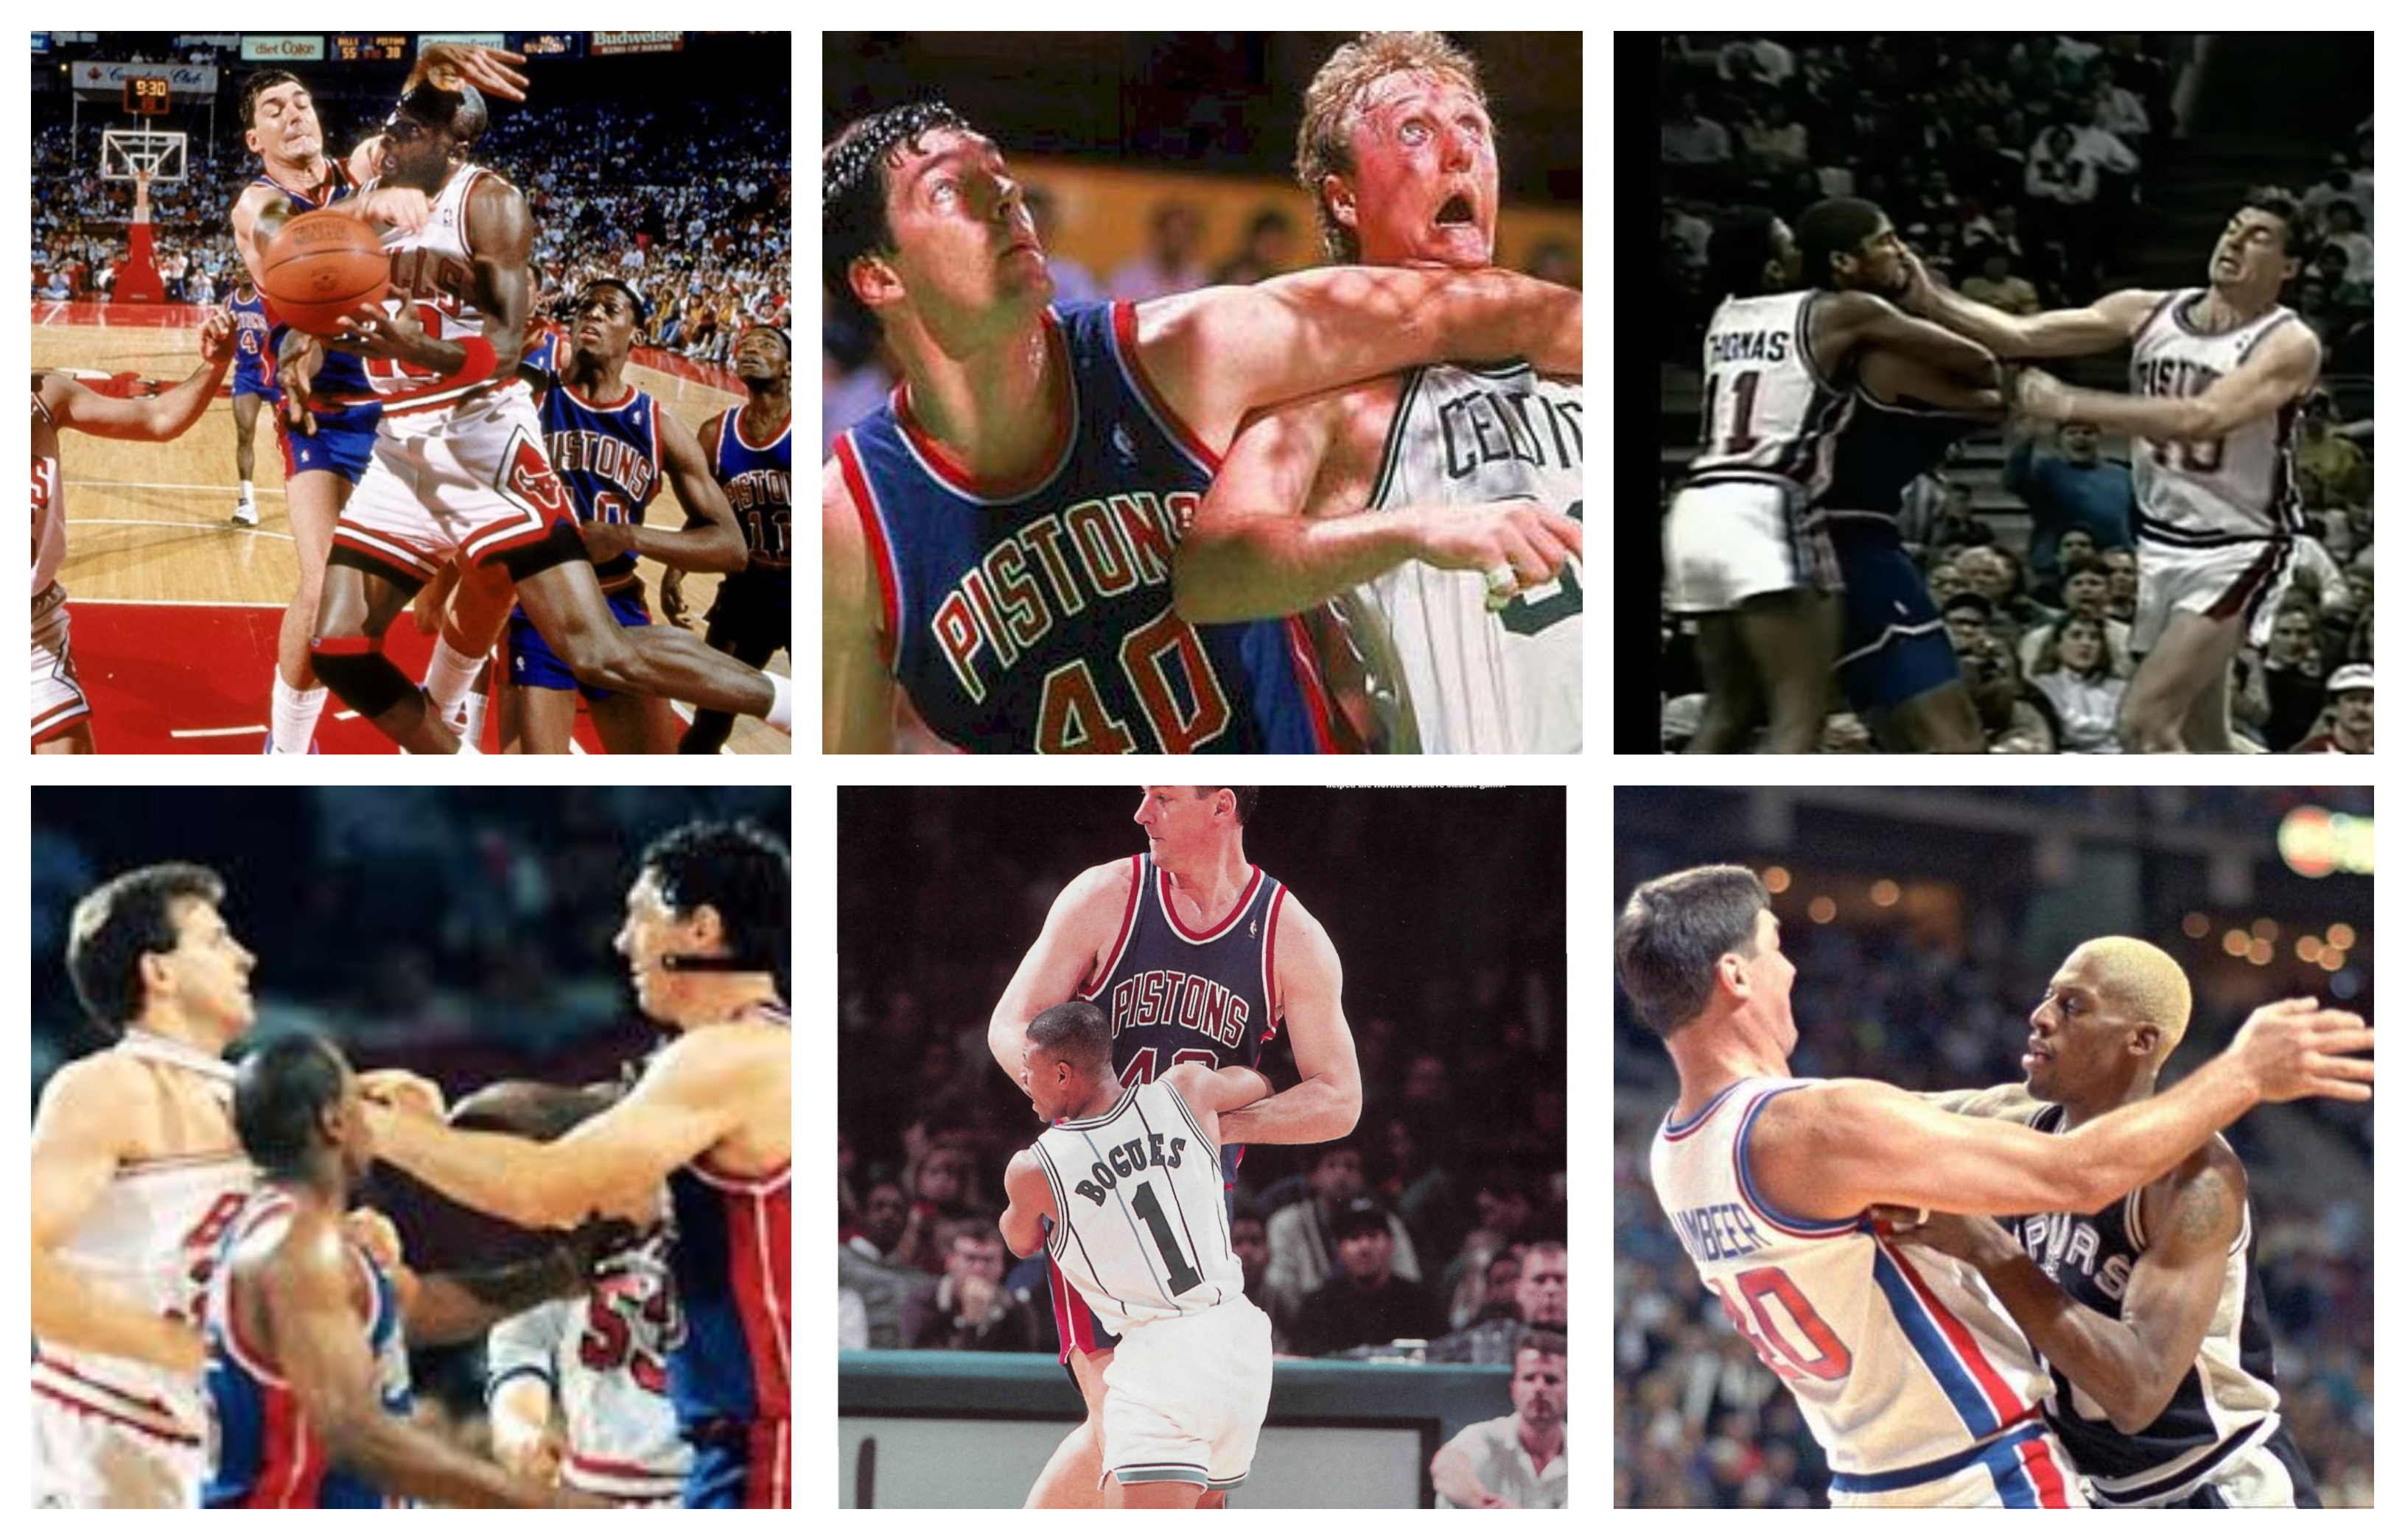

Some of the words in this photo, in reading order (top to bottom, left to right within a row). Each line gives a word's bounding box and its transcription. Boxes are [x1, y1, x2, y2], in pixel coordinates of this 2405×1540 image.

[256, 43, 278, 55] diet
[281, 40, 315, 55] Coke
[592, 31, 683, 45] Budweiser
[135, 80, 167, 96] 9:30
[240, 330, 258, 354] 4
[1112, 970, 1250, 1049] PISTONS
[1074, 1133, 1186, 1207] BOGUES
[1131, 1180, 1202, 1298] 1
[2014, 1212, 2133, 1301] PURS
